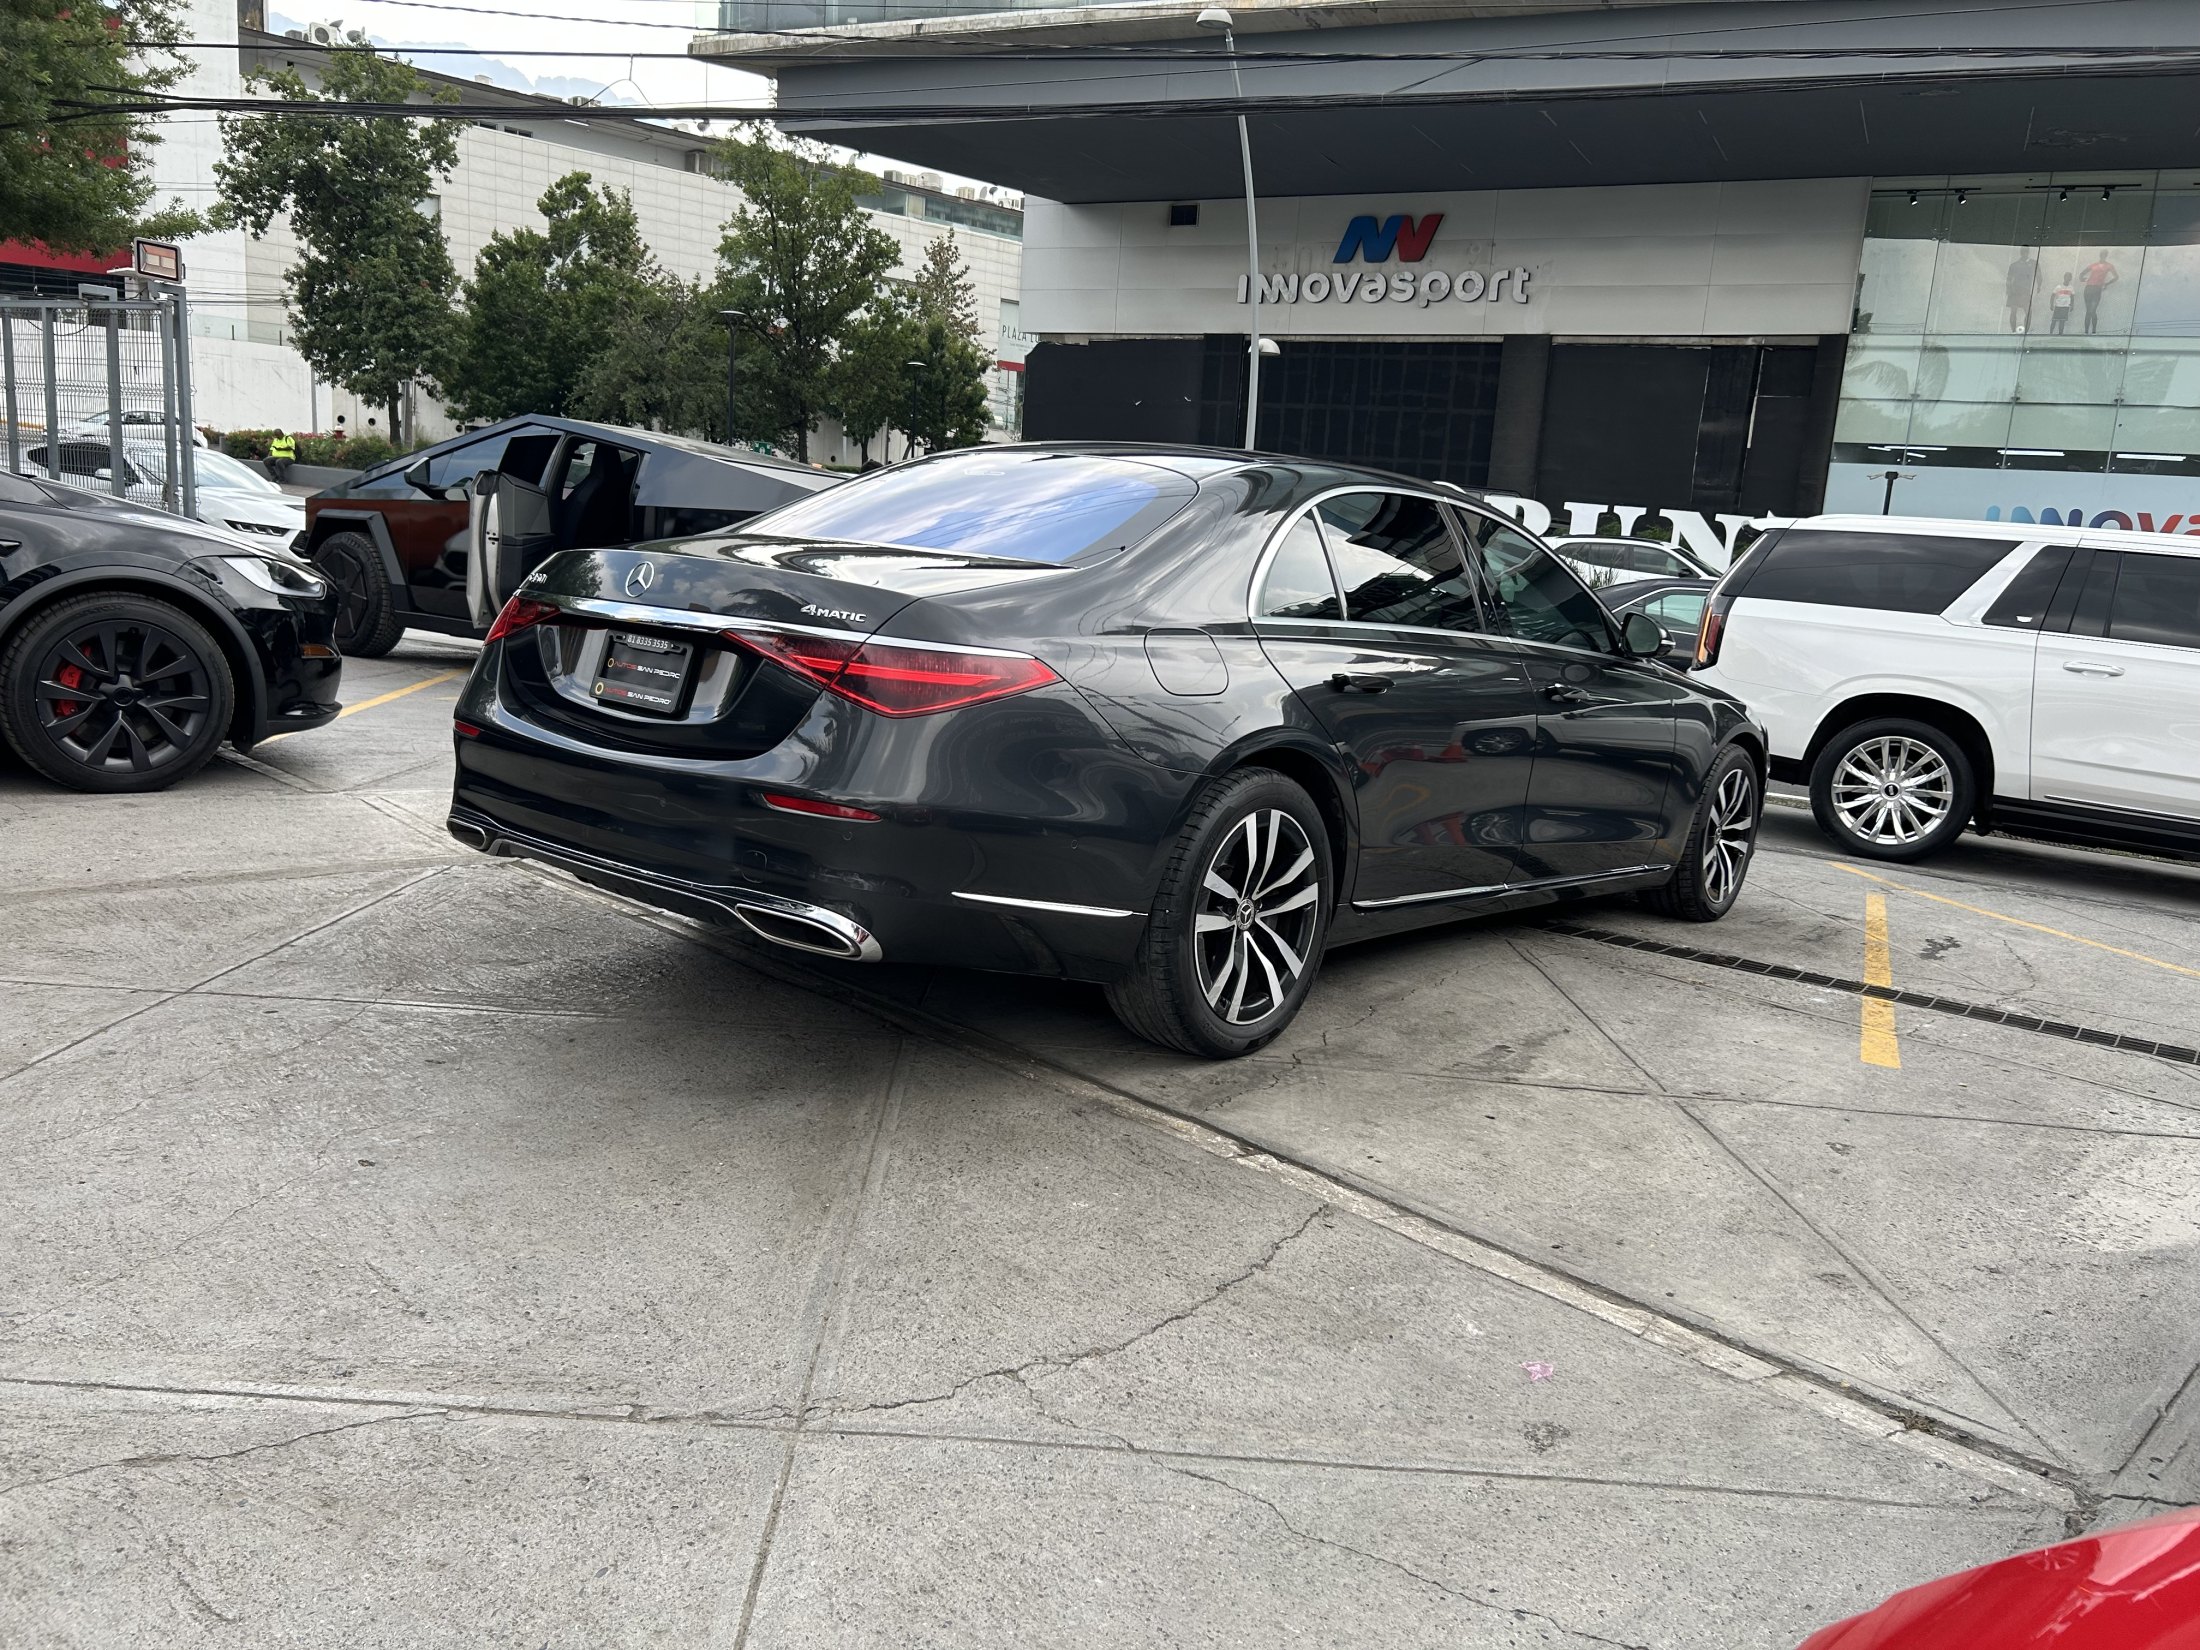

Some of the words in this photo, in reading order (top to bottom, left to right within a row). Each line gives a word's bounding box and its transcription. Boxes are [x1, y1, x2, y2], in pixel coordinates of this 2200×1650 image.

[1002, 325, 1027, 341] PLAZA
[800, 604, 867, 623] 4MATIC
[627, 634, 635, 644] 81
[614, 661, 637, 670] AUTOS
[636, 665, 653, 674] SAN
[604, 687, 627, 697] AUTOS
[627, 691, 644, 700] SAN
